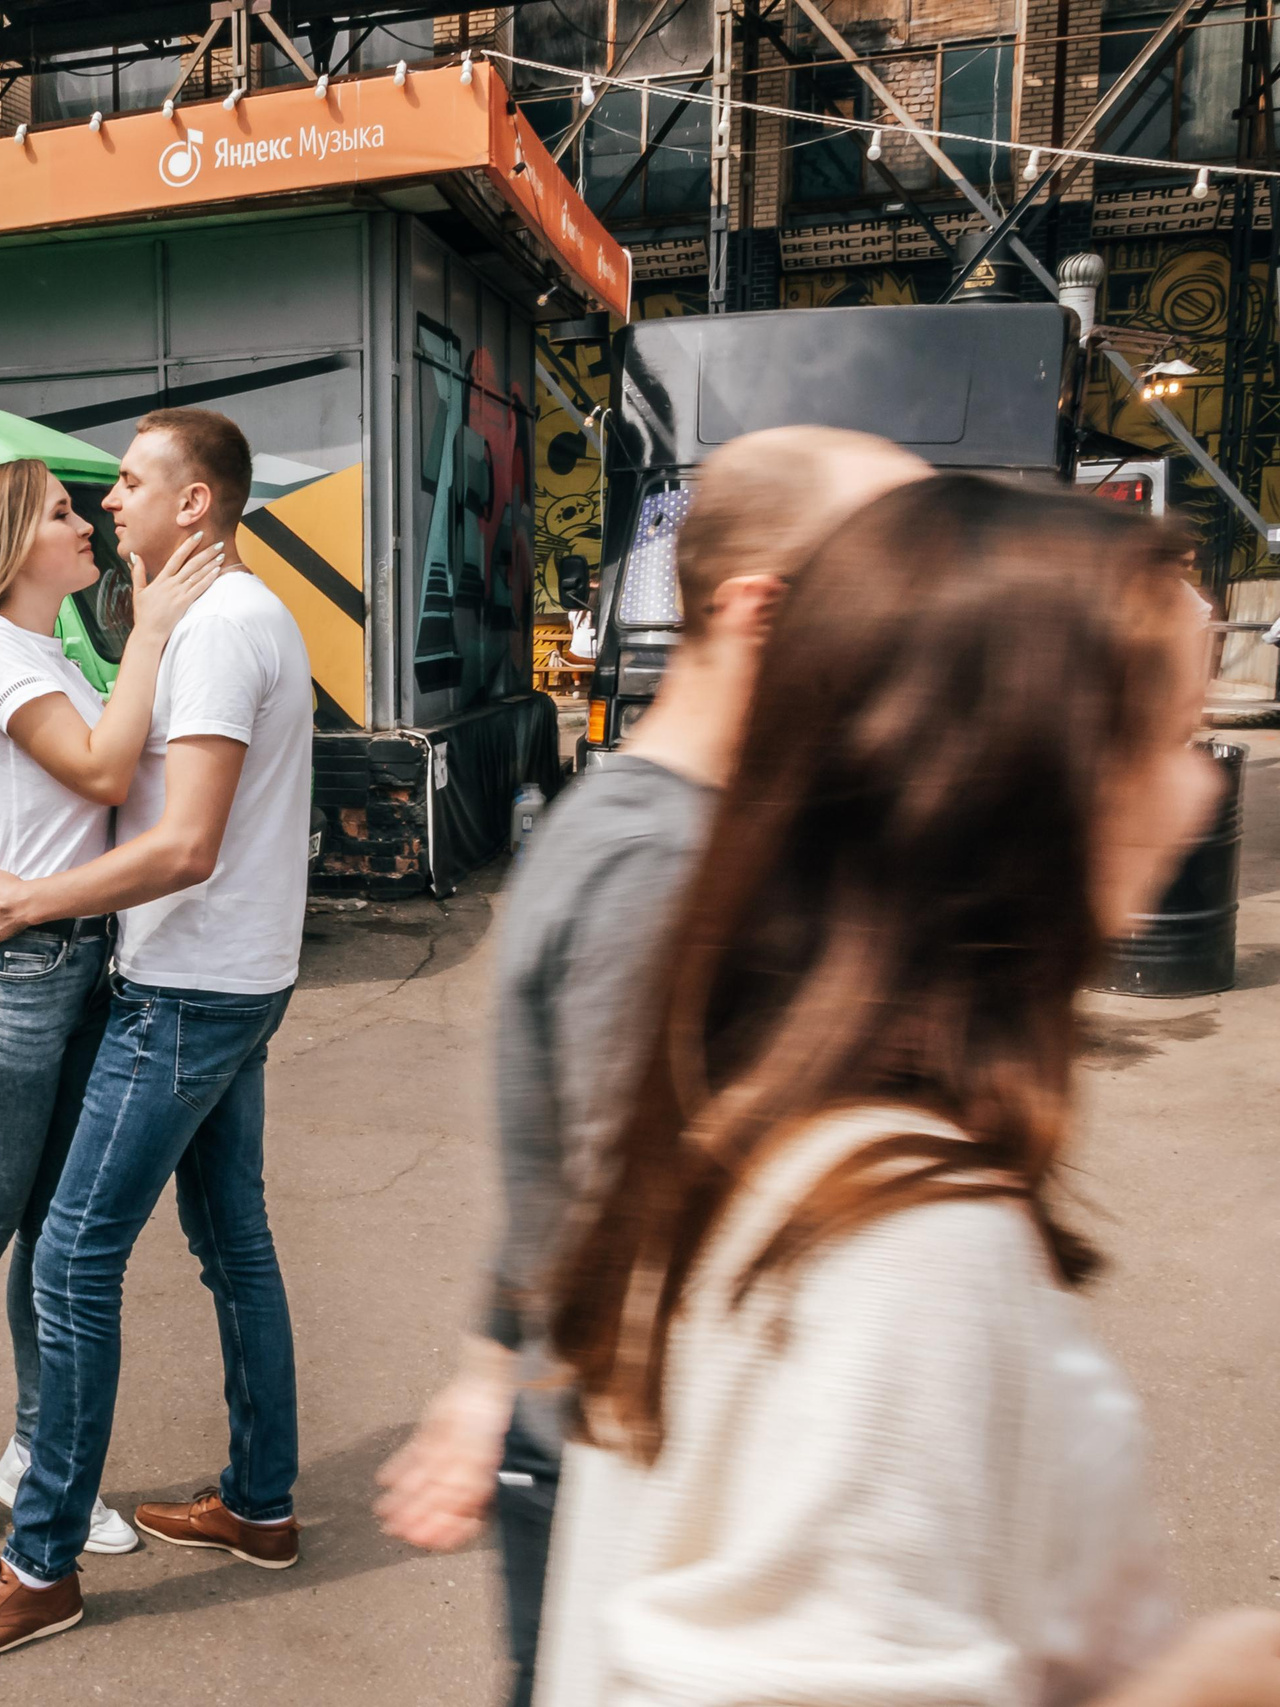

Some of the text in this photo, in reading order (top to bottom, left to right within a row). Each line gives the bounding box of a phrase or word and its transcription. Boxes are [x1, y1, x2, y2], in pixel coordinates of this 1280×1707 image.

[214, 124, 384, 169] Яндекс Музыка
[1094, 200, 1217, 220] BEERCAP
[1092, 216, 1215, 236] BEERCAP
[783, 235, 893, 254] BEERCAP
[785, 250, 893, 268] BEERCAP
